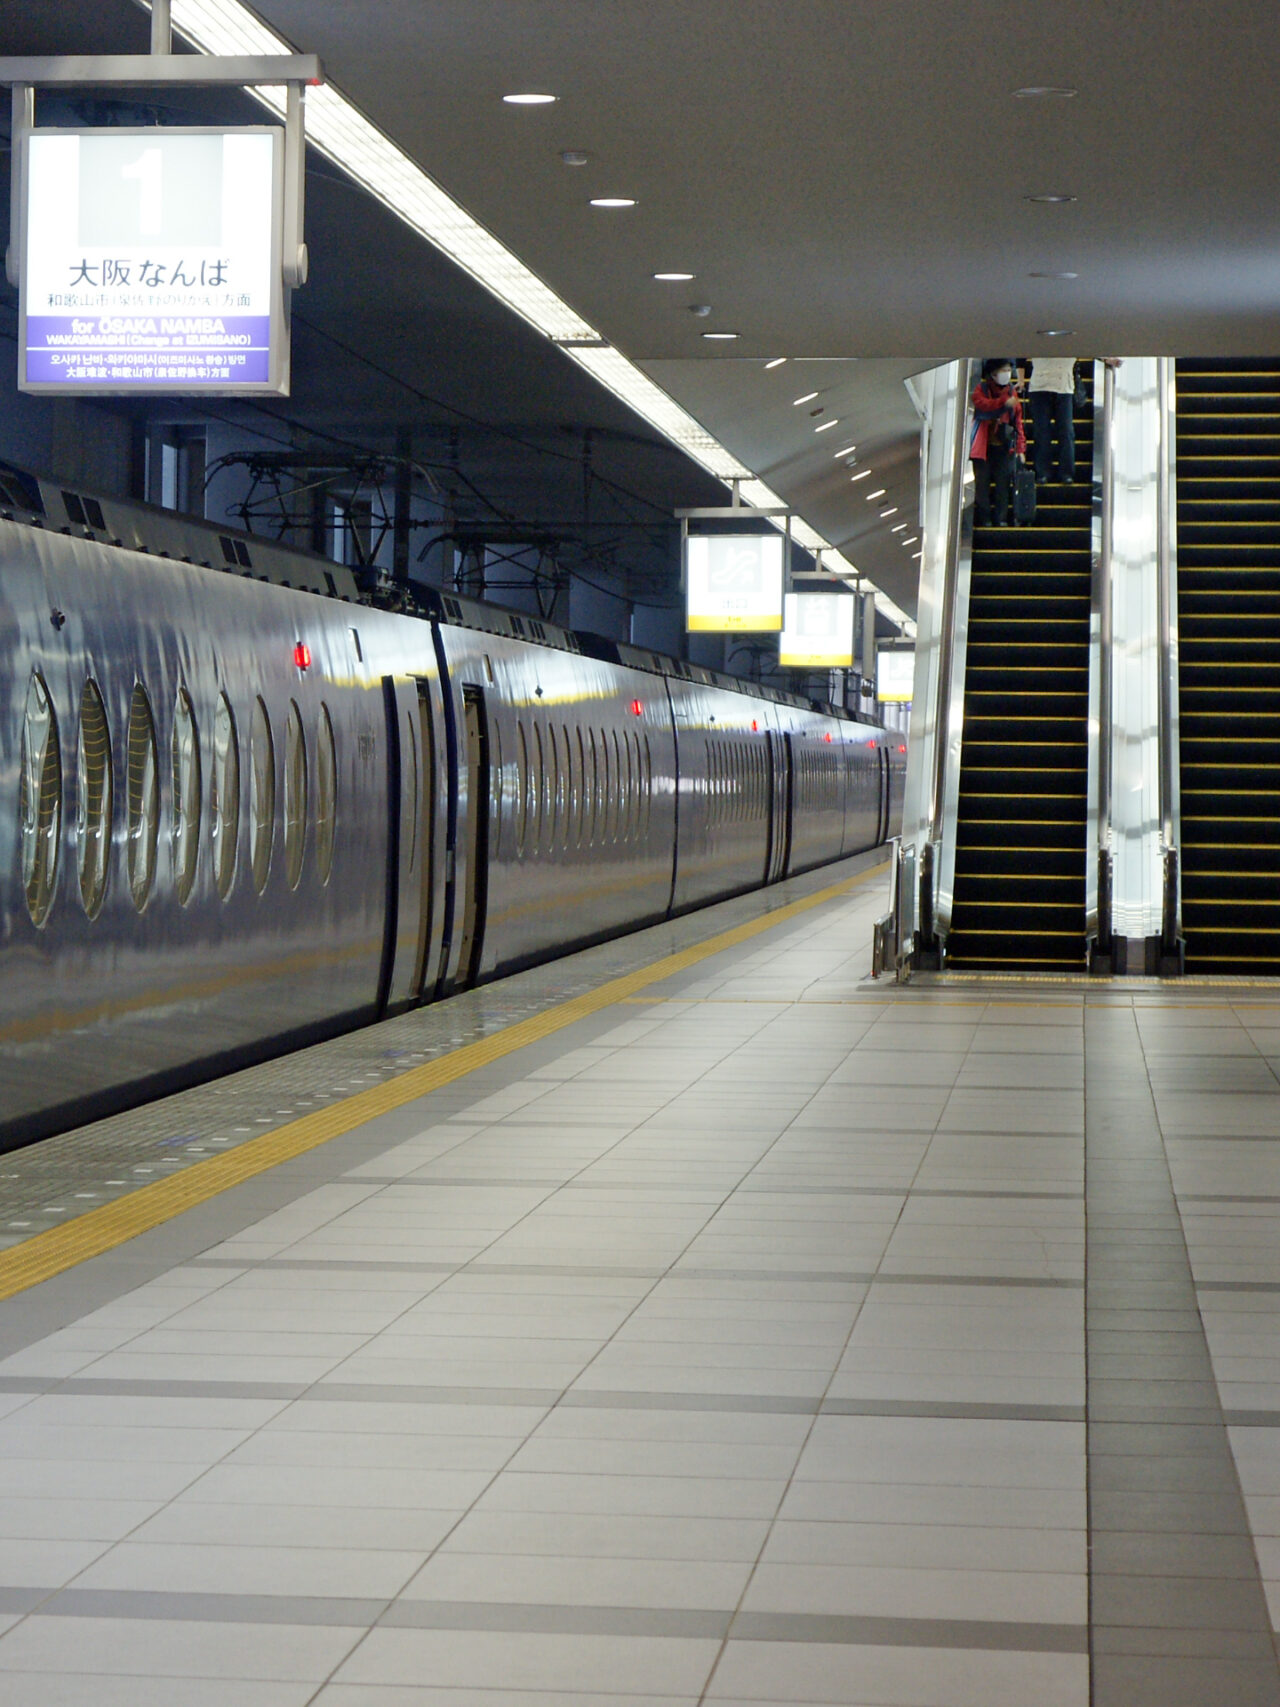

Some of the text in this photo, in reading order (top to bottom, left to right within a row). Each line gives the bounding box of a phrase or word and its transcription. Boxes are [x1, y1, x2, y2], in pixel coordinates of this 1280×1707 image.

[120, 148, 164, 236] 1
[69, 258, 230, 288] 大阪なんば
[71, 318, 94, 334] for
[161, 318, 226, 334] NAMBA
